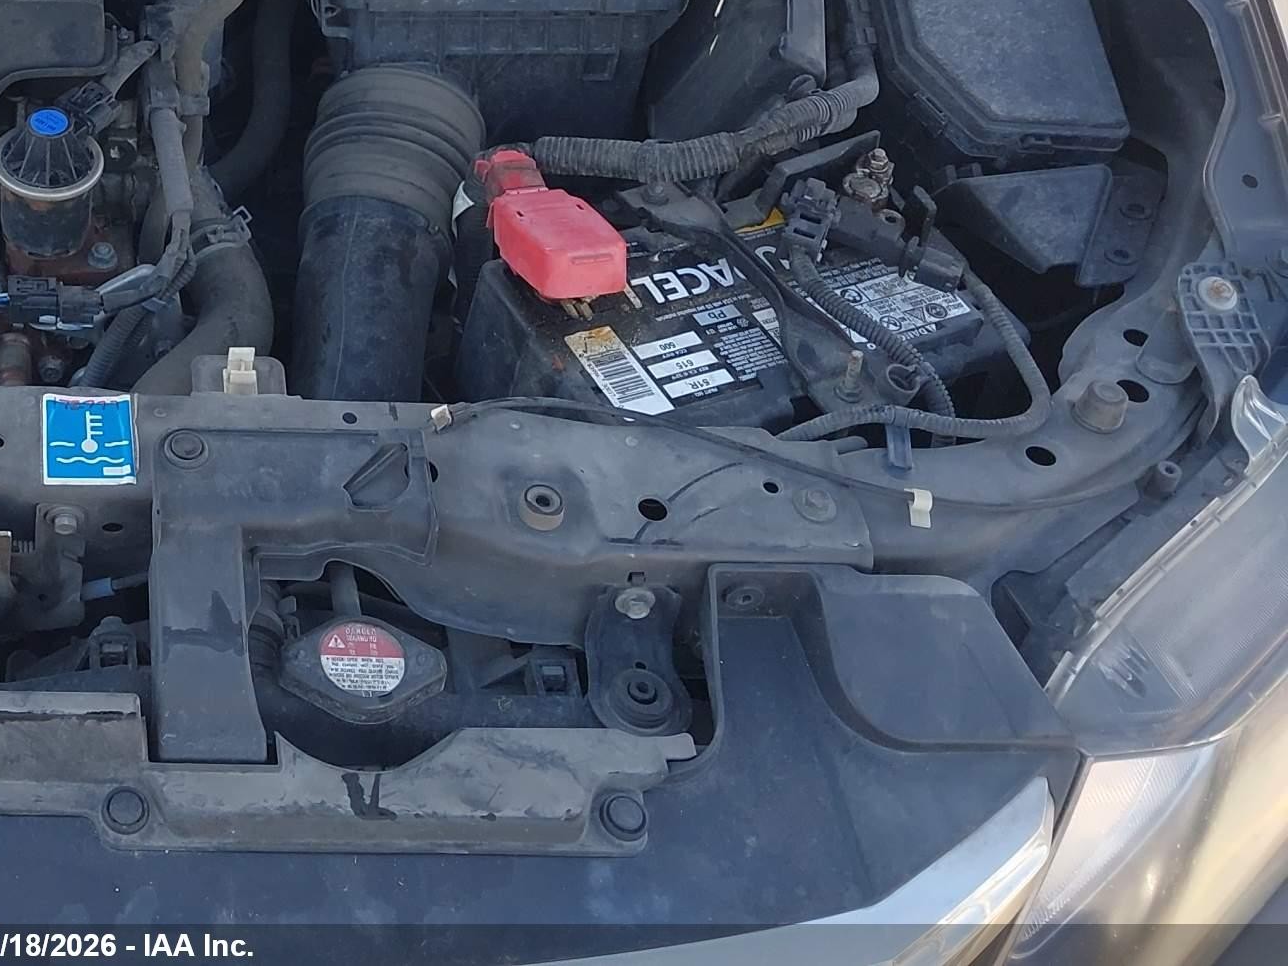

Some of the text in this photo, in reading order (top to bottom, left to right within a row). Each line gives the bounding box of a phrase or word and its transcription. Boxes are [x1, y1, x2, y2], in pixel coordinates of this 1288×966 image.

[707, 309, 728, 320] Pb
[675, 358, 694, 370] 615
[688, 378, 711, 390] 51R
